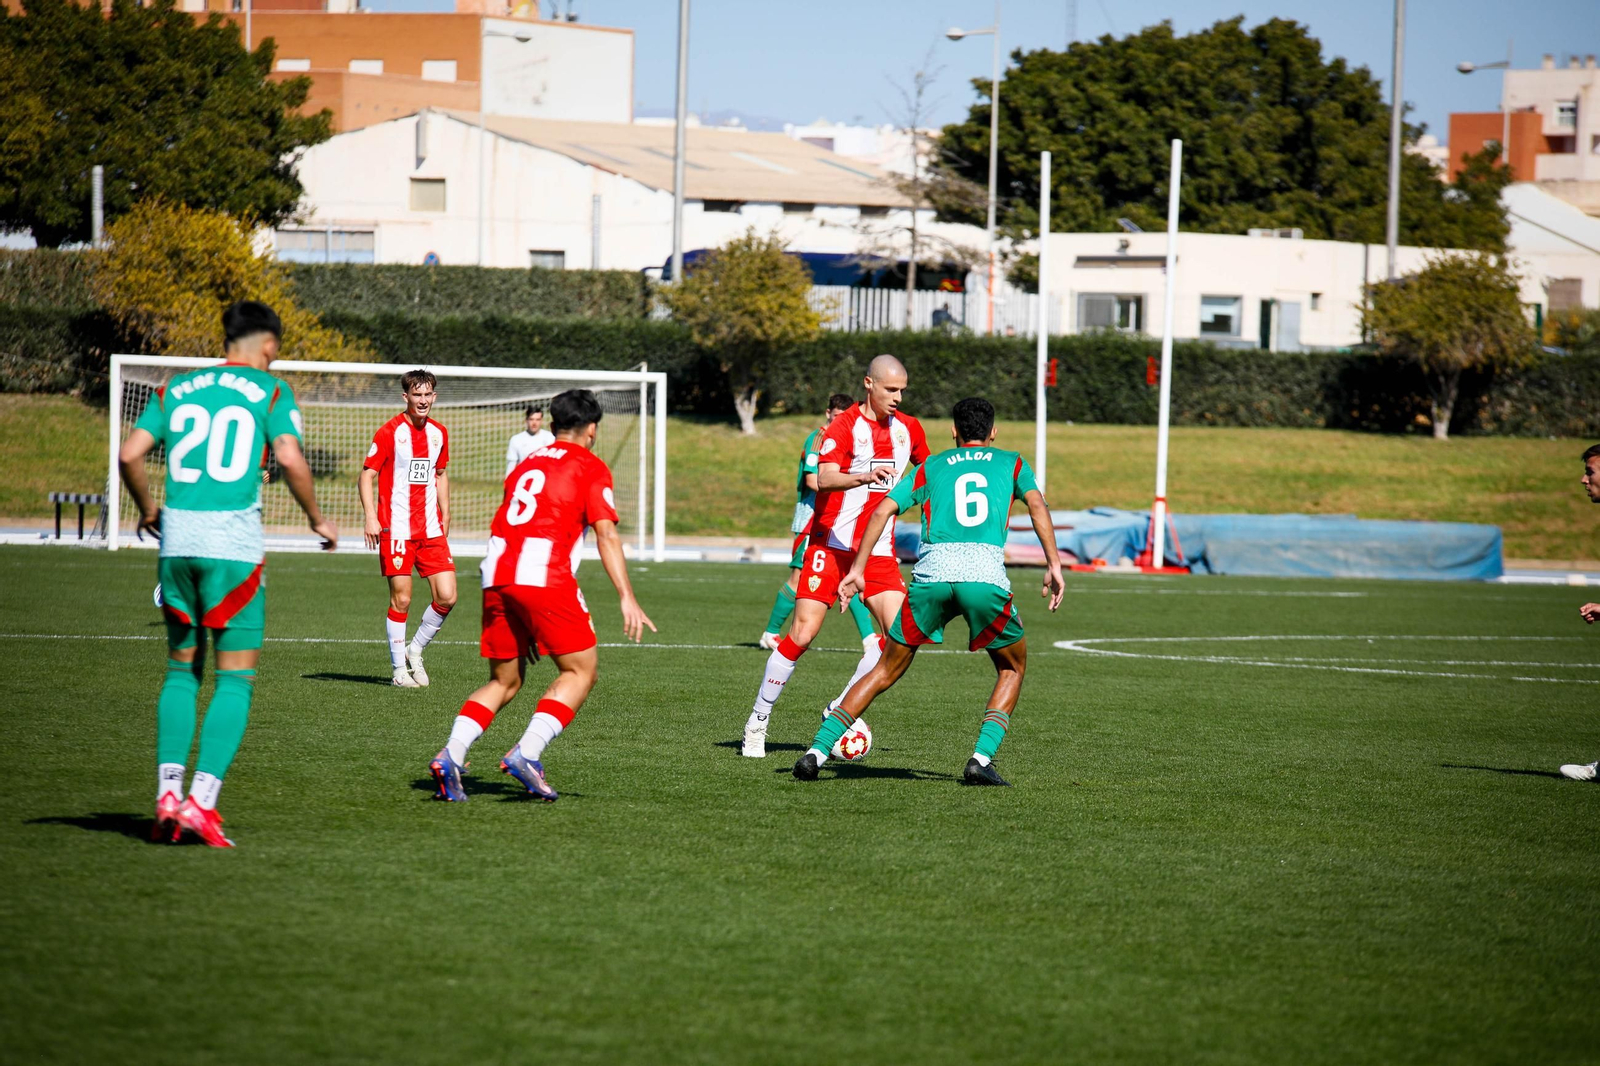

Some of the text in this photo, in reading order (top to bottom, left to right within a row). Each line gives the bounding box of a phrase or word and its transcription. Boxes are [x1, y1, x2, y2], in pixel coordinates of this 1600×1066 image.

[168, 403, 256, 484] 20
[946, 451, 993, 466] ULLOA
[506, 469, 546, 526] 8
[954, 472, 989, 527] 6
[390, 539, 406, 555] 14
[812, 550, 827, 573] 6
